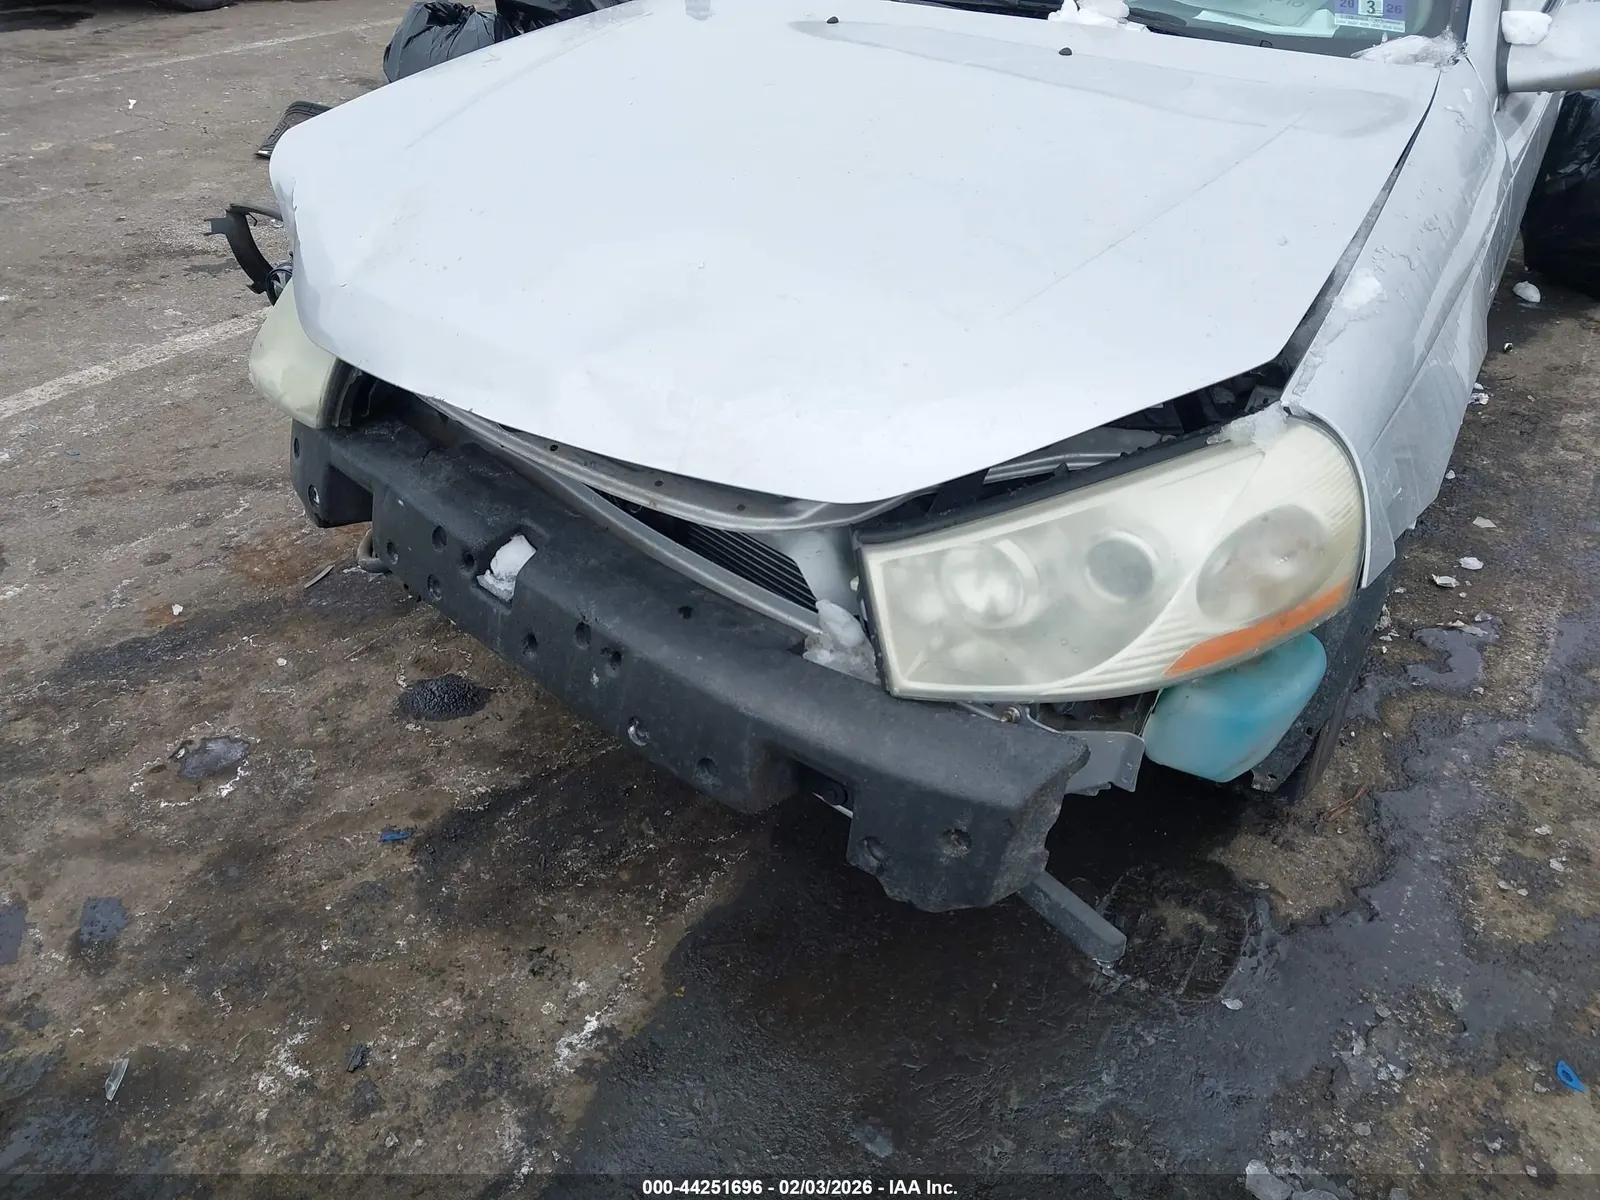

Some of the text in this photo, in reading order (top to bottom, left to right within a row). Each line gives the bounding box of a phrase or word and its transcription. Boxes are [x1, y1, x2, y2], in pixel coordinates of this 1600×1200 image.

[1340, 0, 1403, 14] 20 3 26
